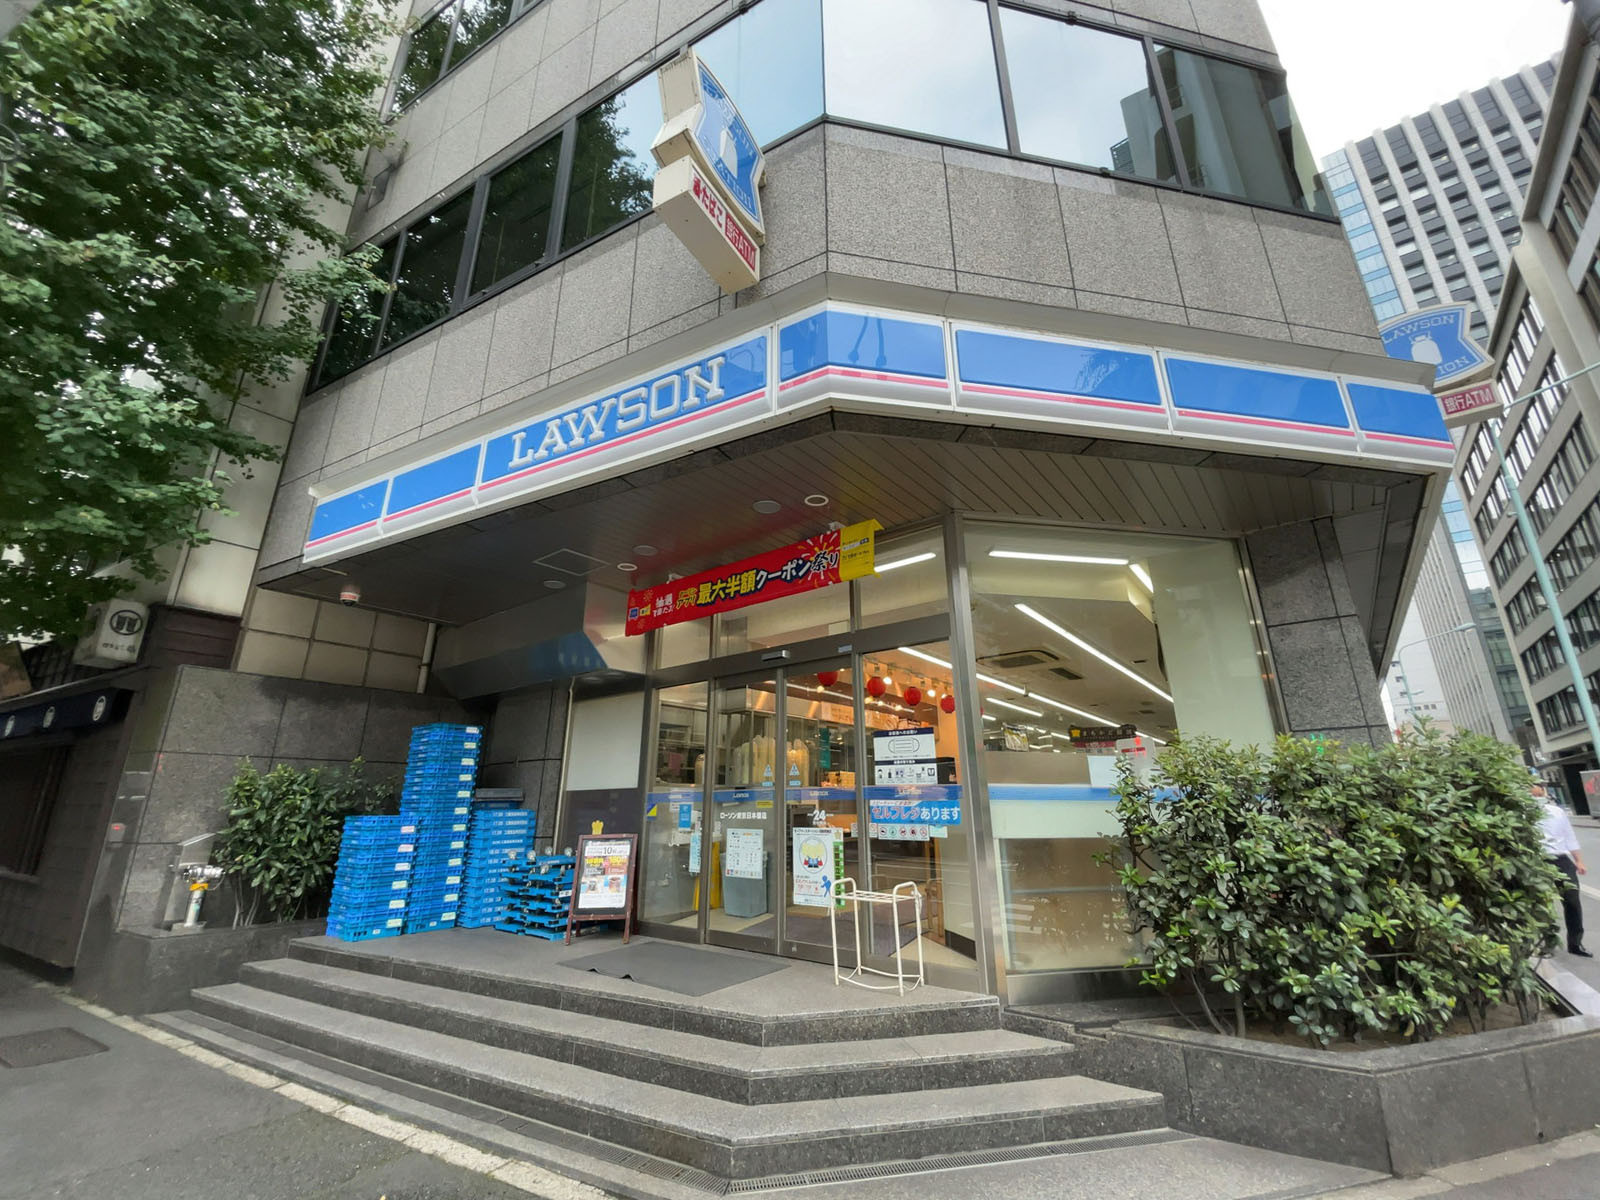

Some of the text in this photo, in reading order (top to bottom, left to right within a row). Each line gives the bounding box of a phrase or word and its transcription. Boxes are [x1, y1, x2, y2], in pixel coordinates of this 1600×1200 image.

[1382, 314, 1456, 344] LAWSON
[508, 355, 725, 470] LAWSON
[1444, 388, 1494, 413] 銀行ATM
